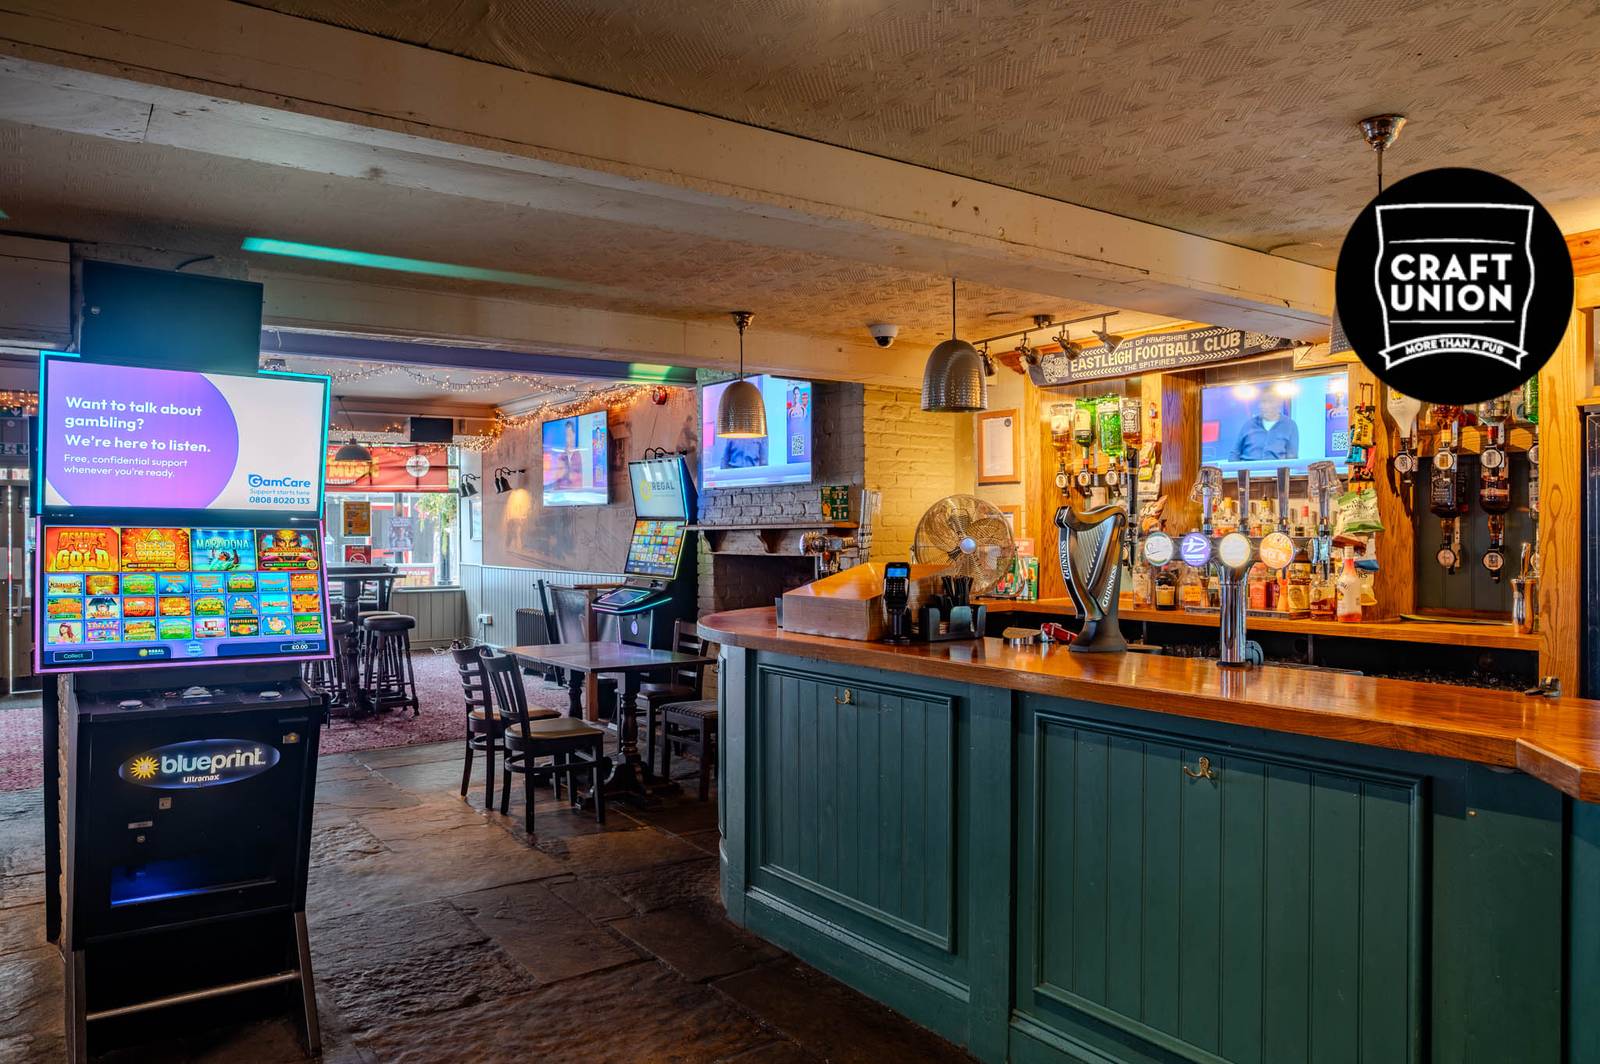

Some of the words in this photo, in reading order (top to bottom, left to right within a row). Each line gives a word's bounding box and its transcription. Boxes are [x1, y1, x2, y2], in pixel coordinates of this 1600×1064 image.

[1135, 339, 1144, 347] OF
[1146, 333, 1188, 345] HAMPSHIRE
[1071, 350, 1132, 373] EASTLEIGH
[1135, 340, 1200, 362] FOOTBALL
[1204, 331, 1241, 352] CLUB
[1124, 364, 1137, 372] THE
[1139, 358, 1176, 370] SPITFIRES
[66, 396, 107, 410] Want
[110, 400, 126, 411] to
[129, 401, 157, 413] talk
[160, 403, 202, 416] about
[65, 416, 144, 432] gambling?
[64, 434, 111, 447] We're
[114, 437, 148, 449] here
[151, 440, 166, 450] to
[169, 439, 211, 453] listen.
[92, 455, 150, 465] confidential
[152, 459, 187, 468] support
[64, 466, 112, 475] whenever
[114, 468, 144, 477] you're
[146, 469, 175, 478] ready.
[248, 474, 311, 488] GamCare
[652, 481, 675, 490] REGAL
[249, 488, 275, 496] Support
[249, 496, 272, 504] 0808
[297, 497, 311, 505] 133
[196, 539, 249, 550] MARADONA
[56, 549, 110, 569] GOLD
[1060, 540, 1070, 580] GUINNESS
[1102, 565, 1118, 607] GUINNESS
[161, 748, 263, 774] blueprint
[183, 774, 220, 784] Ultramax
